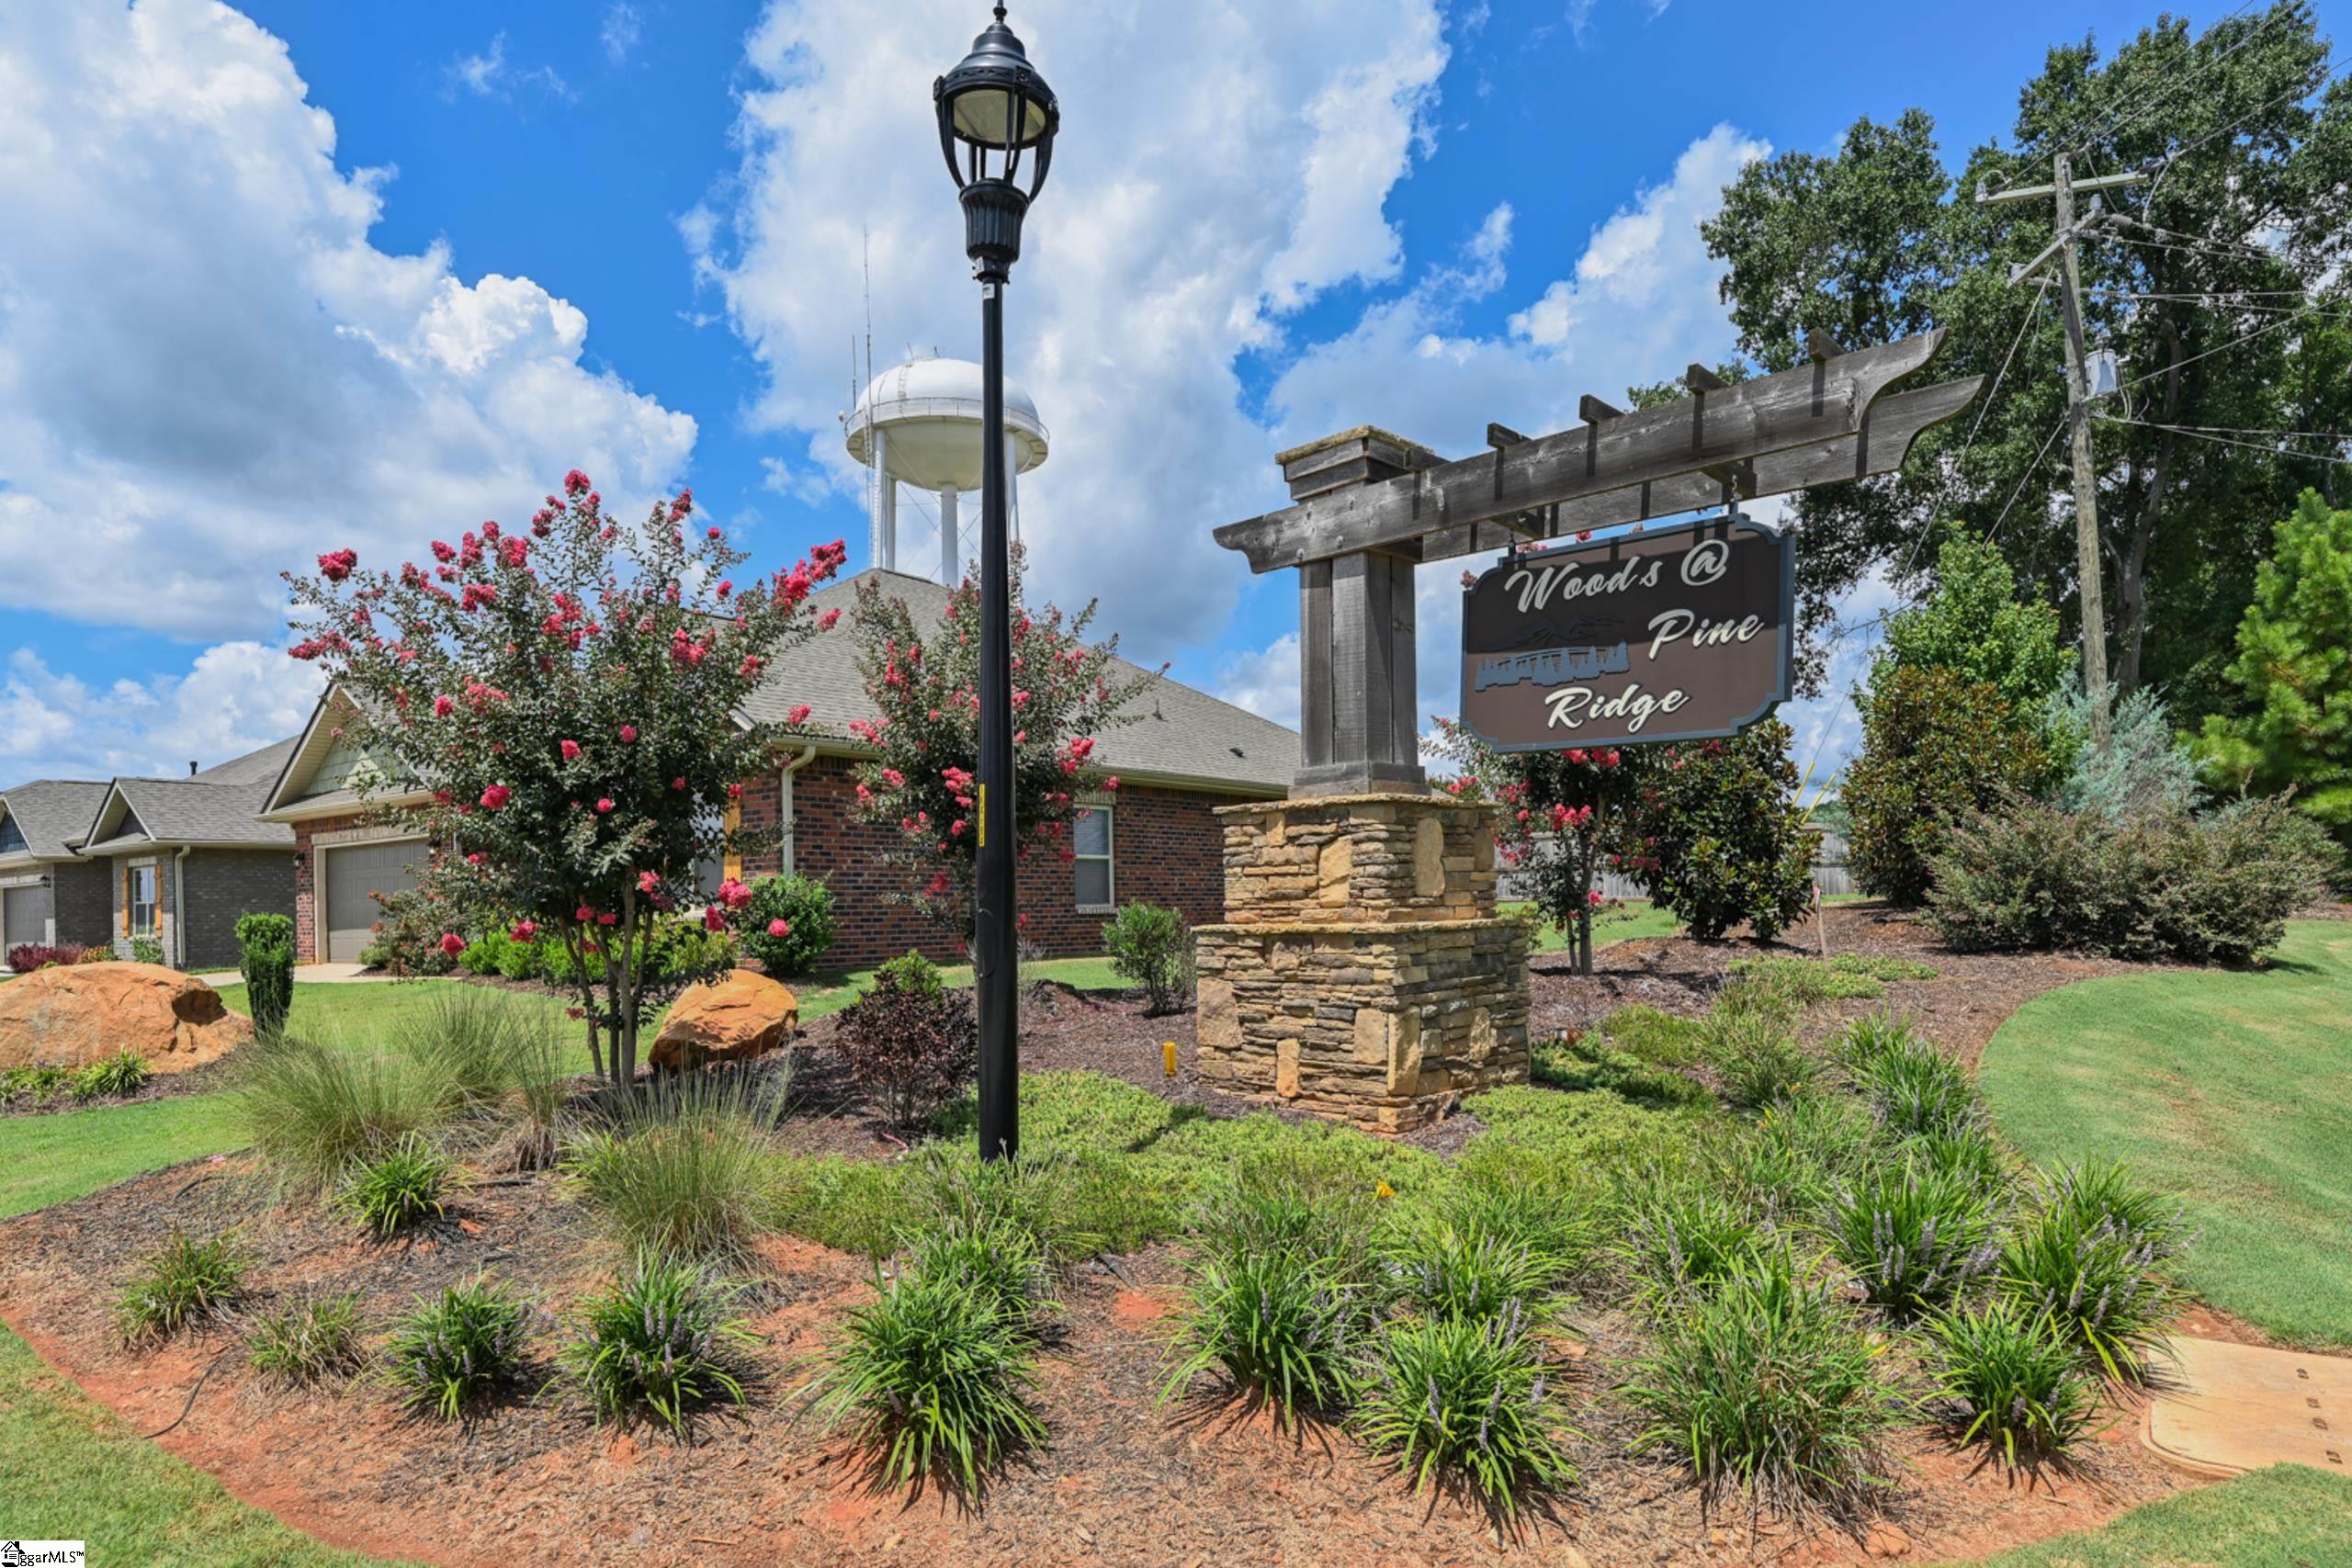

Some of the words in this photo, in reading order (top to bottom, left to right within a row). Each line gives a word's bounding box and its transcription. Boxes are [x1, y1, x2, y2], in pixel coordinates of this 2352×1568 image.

[1504, 556, 1663, 614] Woods
[1680, 538, 1729, 586] @
[1647, 608, 1764, 660] Pine
[1544, 683, 1690, 733] Ridge
